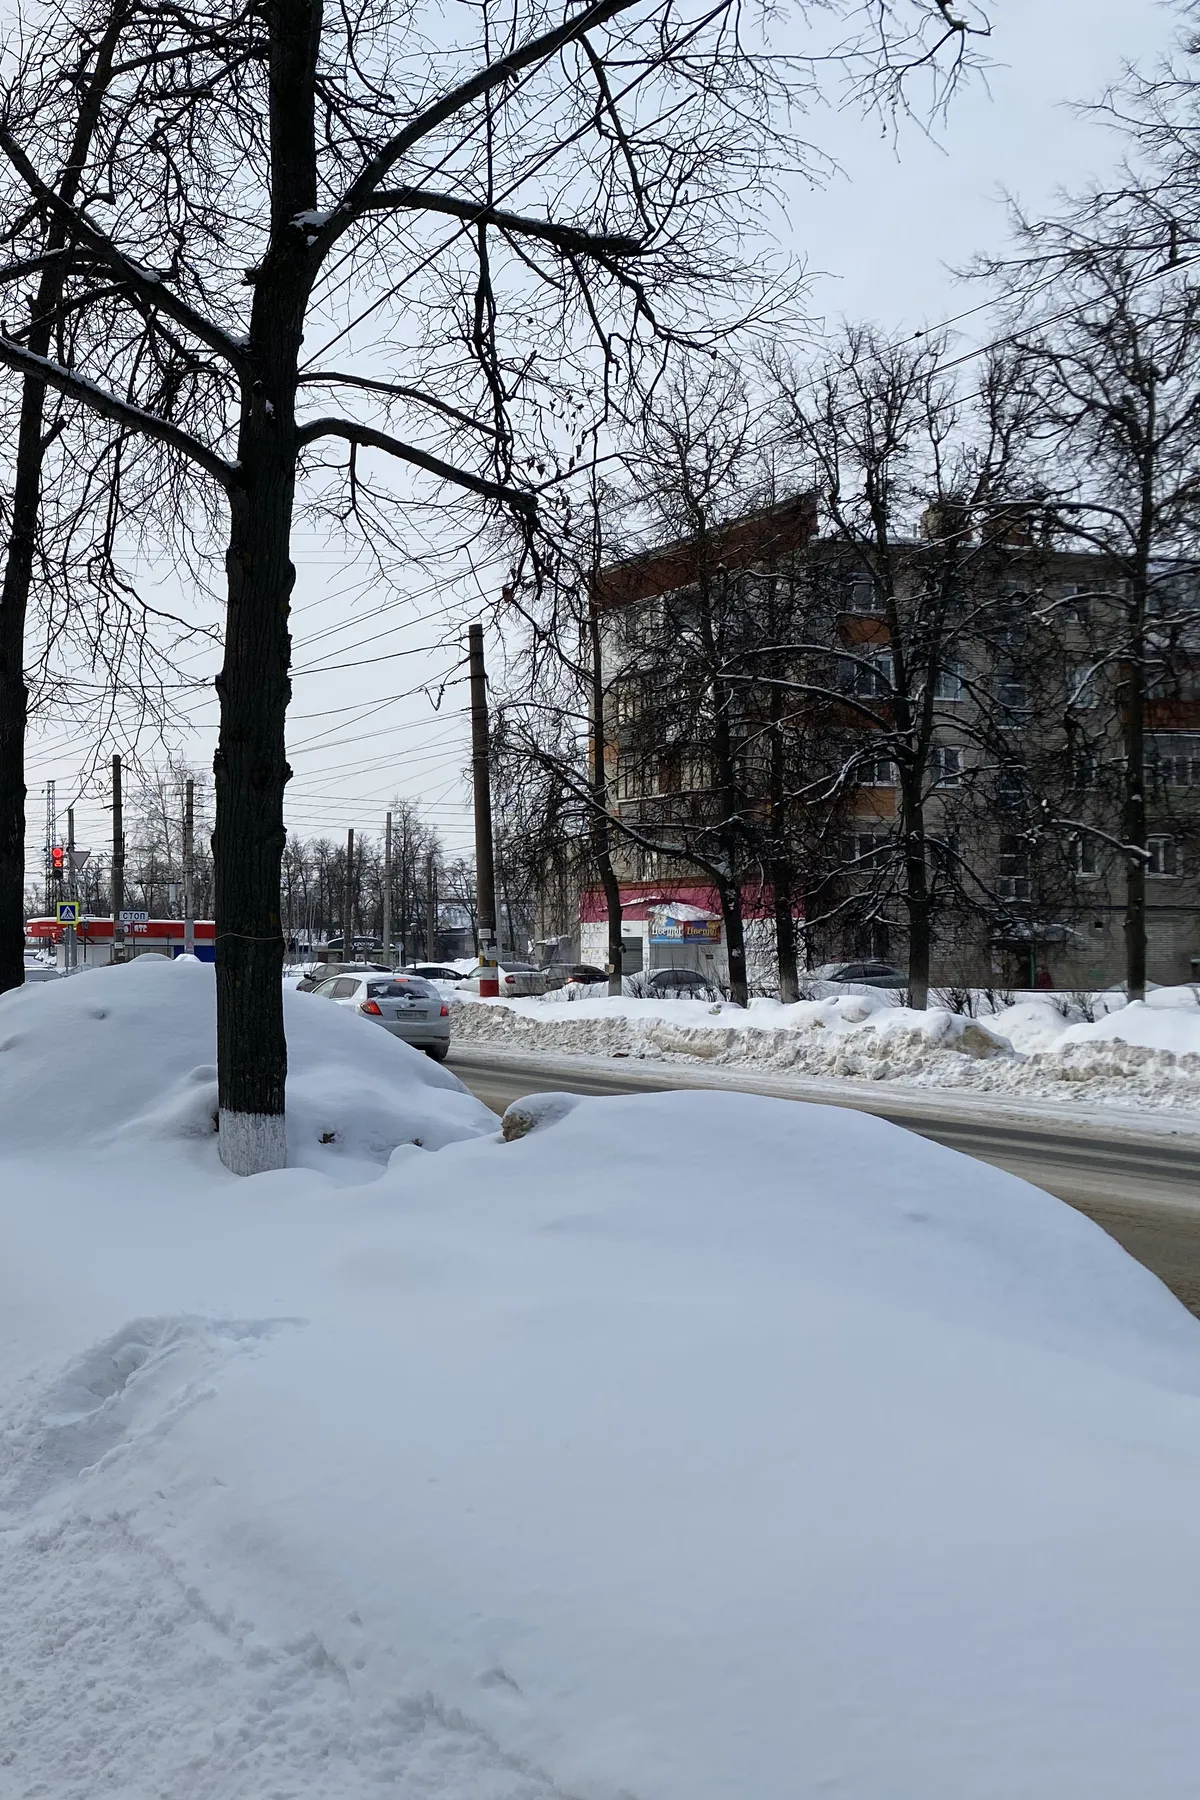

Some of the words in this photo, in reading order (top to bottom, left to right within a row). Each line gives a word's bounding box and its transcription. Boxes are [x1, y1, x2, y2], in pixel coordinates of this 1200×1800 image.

[122, 912, 146, 920] СТОП
[651, 925, 684, 938] Цветы
[686, 926, 718, 938] Цветы
